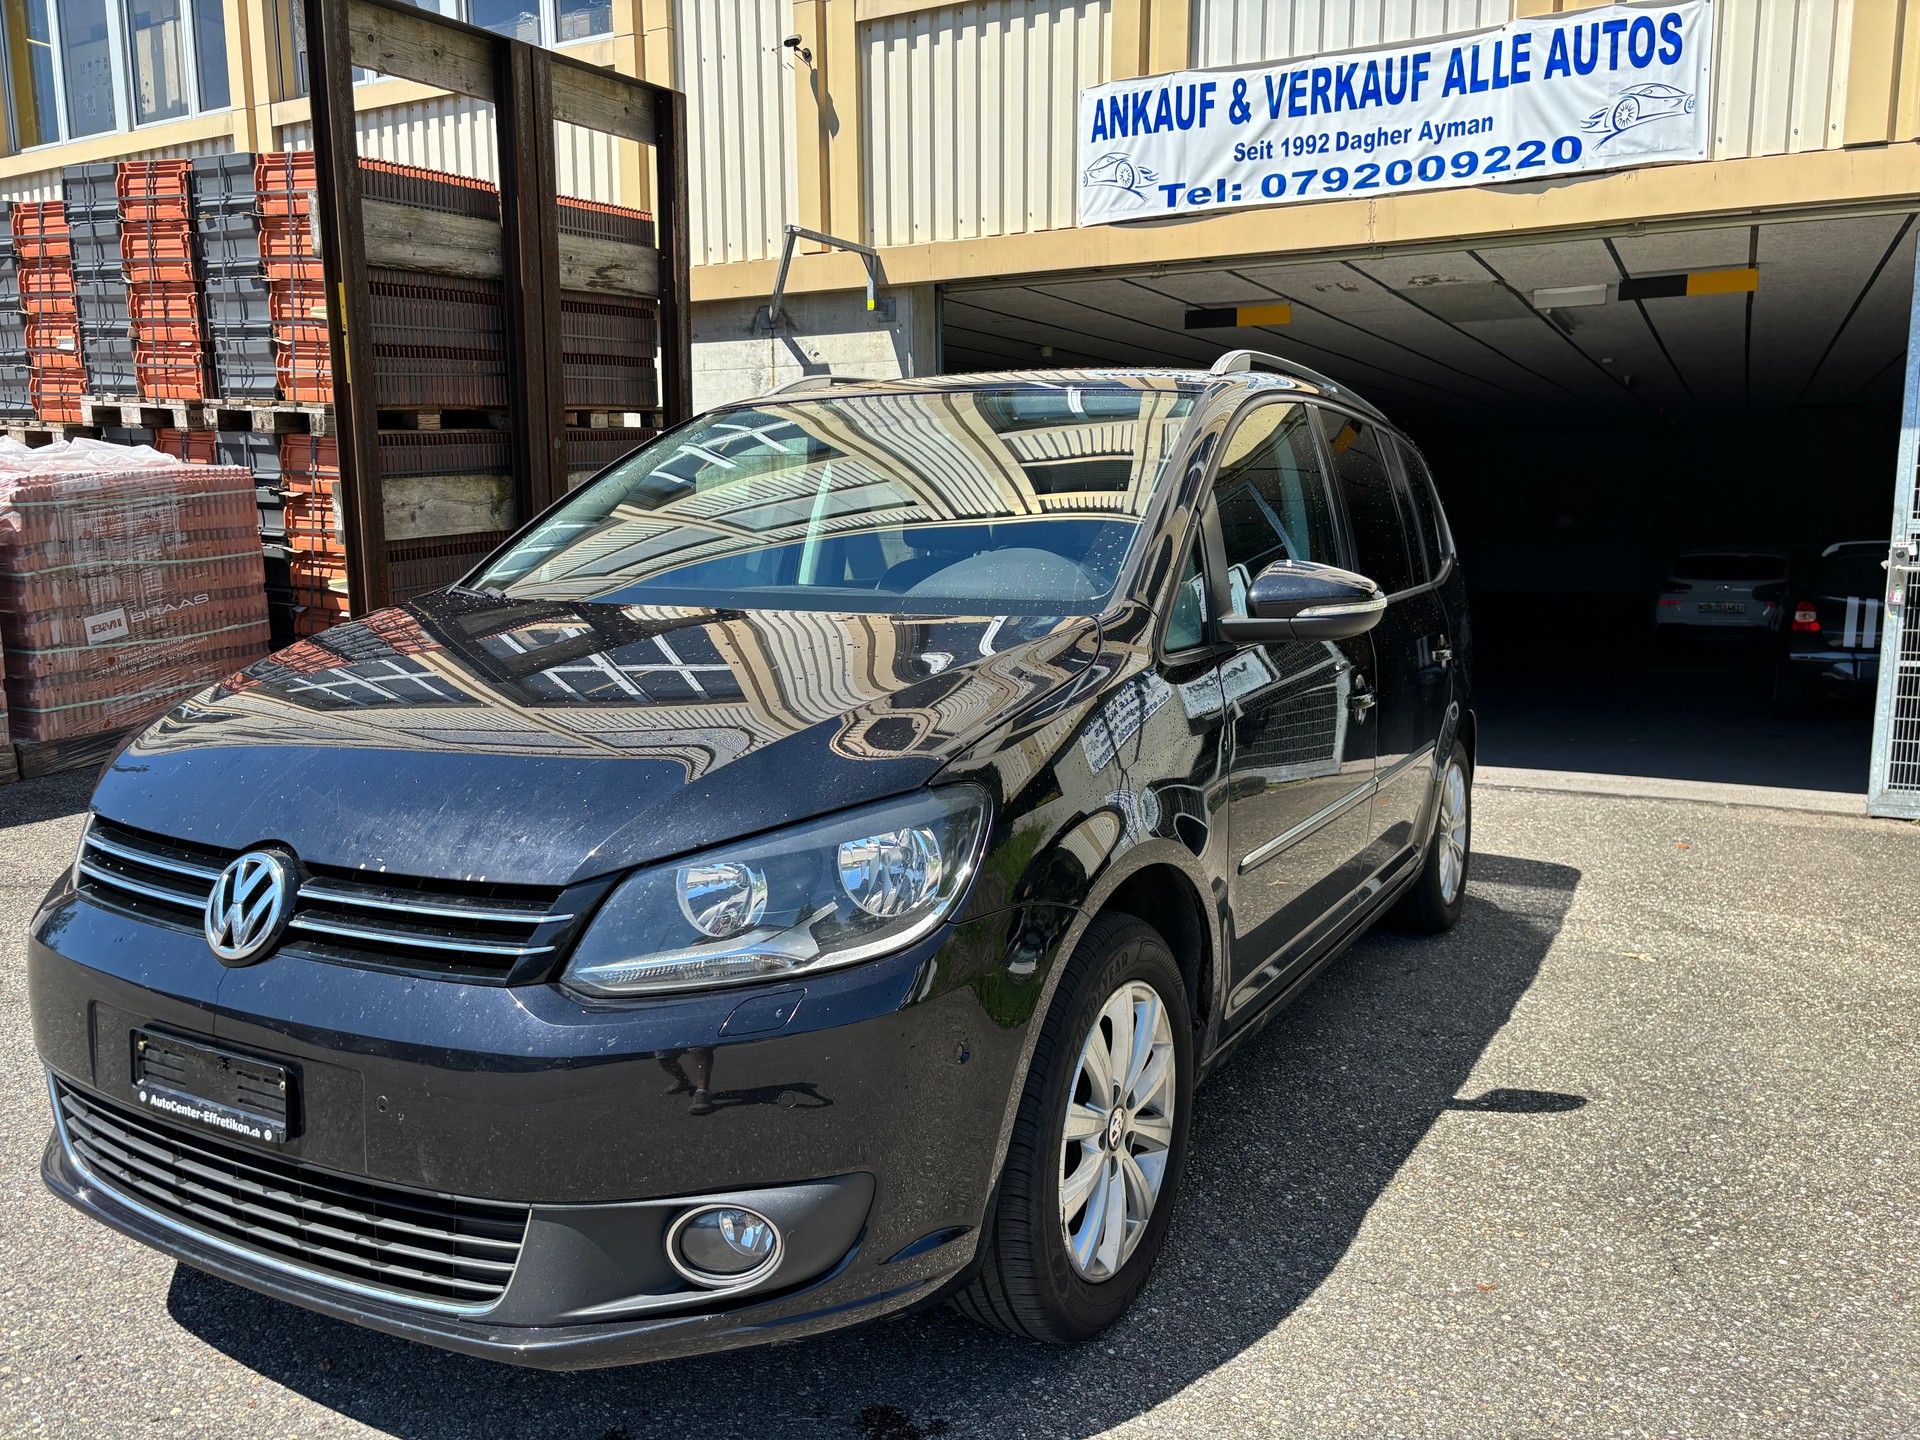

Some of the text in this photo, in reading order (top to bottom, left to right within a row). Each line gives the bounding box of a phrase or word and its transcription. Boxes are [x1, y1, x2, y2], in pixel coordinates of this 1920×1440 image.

[1091, 12, 1684, 144] ANKAUF & VERKAUF ALLE AUTOS
[1233, 115, 1494, 162] Seit 1992 Dagher Ayman
[1158, 135, 1583, 208] Tel: 0792009220
[130, 593, 210, 623] BRAAS
[205, 851, 285, 960] VW
[150, 1094, 261, 1139] AutoCenter-Effretikon.ch
